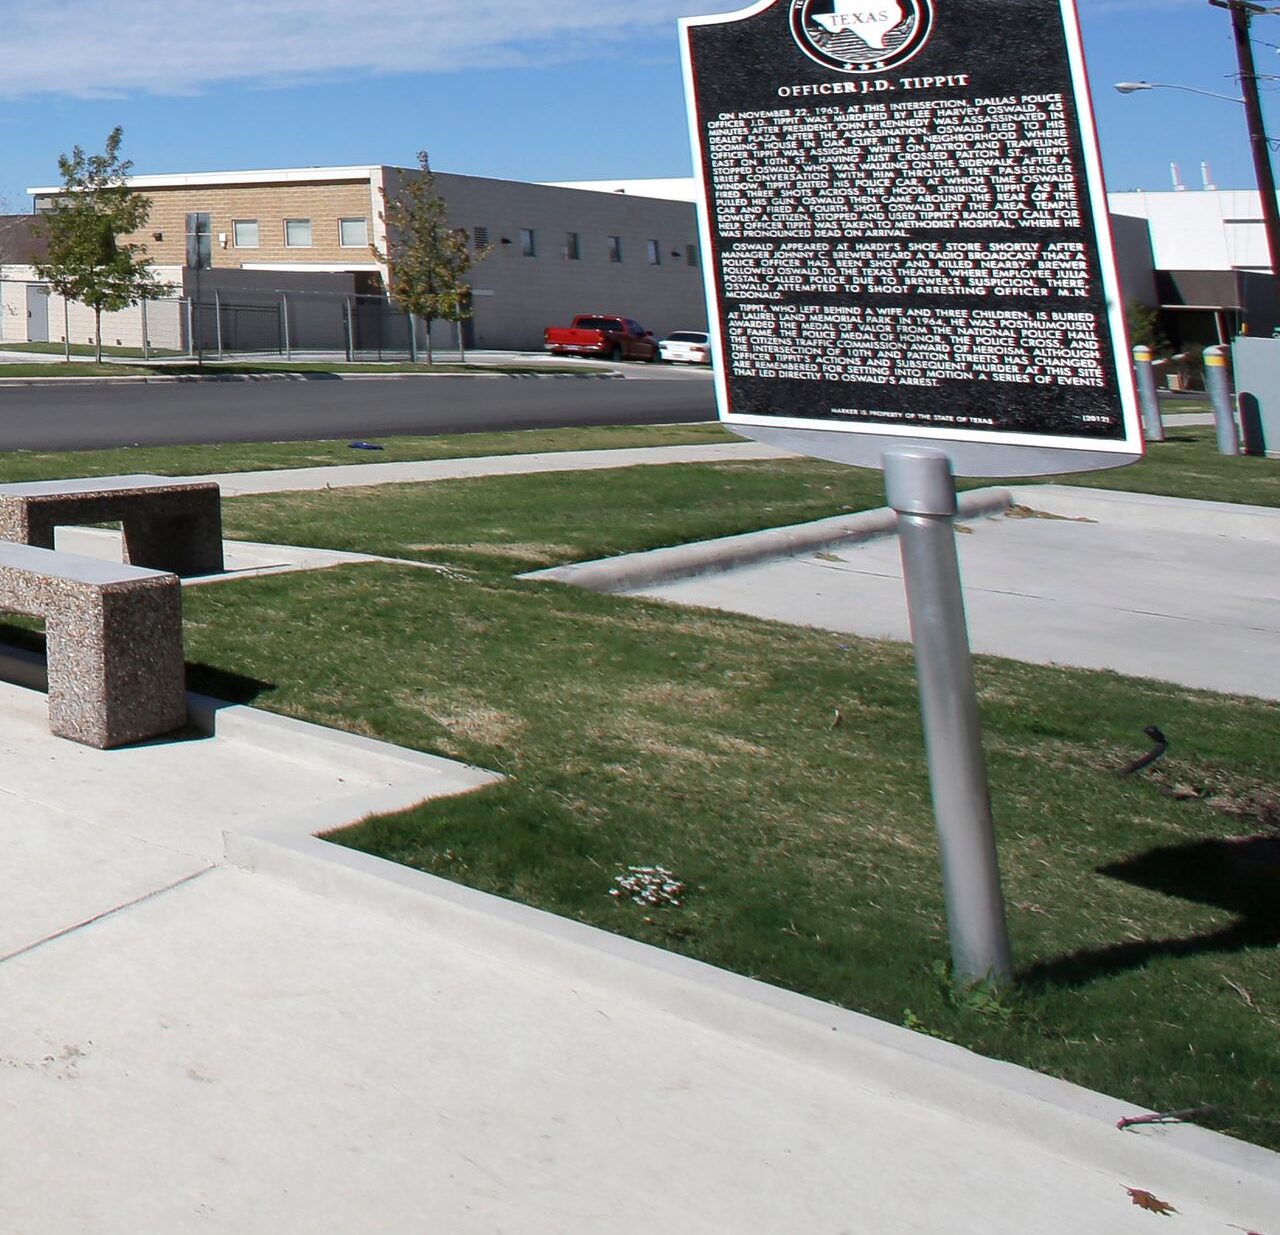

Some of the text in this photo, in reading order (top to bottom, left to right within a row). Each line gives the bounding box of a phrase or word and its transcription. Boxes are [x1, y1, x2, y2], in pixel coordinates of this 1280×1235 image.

[830, 10, 889, 27] TEXAS
[777, 74, 969, 97] OFFICER J.D. TIPPIT
[707, 120, 745, 129] OFFICER
[773, 117, 799, 126] TIPPIT
[804, 115, 828, 124] WAS
[833, 112, 888, 122] MURDERED
[893, 111, 907, 119] BY
[913, 110, 931, 118] LEE
[937, 107, 980, 117] HARVEY
[1048, 103, 1063, 111] 45
[718, 112, 735, 121] ON
[738, 109, 791, 120] NOVEMBER
[847, 105, 860, 114] AT
[864, 104, 886, 113] THIS
[975, 97, 1016, 107] DALLAS
[1021, 94, 1062, 104] POLICE
[709, 135, 743, 145] DEALEY
[785, 132, 814, 141] AFTER
[820, 131, 838, 140] THE
[936, 124, 984, 134] OSWALD
[990, 123, 1017, 132] FLED
[1023, 122, 1040, 130] TO
[1046, 120, 1066, 129] HIS
[710, 151, 748, 160] OFFICER
[753, 149, 779, 158] TIPPIT
[782, 148, 805, 157] WAS
[868, 145, 902, 154] WHILE
[906, 144, 925, 152] ON
[929, 142, 969, 151] PATROL
[974, 141, 1000, 149] AND
[1006, 138, 1068, 148] TRAVELING
[713, 165, 1072, 183] BRIEF CONVERSATION WITH HIM THROUGH THE PASSENGER
[766, 181, 791, 189] TIPPIT
[796, 180, 829, 189] EXITED
[833, 179, 850, 188] HIS
[854, 178, 891, 187] POLICE
[926, 177, 940, 185] AT
[945, 176, 985, 185] WHICH
[990, 175, 1016, 184] TIME
[1021, 174, 1074, 183] OSWALD
[716, 198, 748, 206] PULLED
[751, 198, 767, 206] HIS
[801, 196, 845, 205] OSWALD
[849, 196, 877, 204] THEN
[881, 195, 912, 203] CAME
[917, 194, 966, 203] AROUND
[971, 194, 992, 202] THE
[996, 193, 1026, 201] REAR
[1031, 192, 1049, 200] OF
[1054, 192, 1076, 200] THE
[744, 222, 783, 230] OFFICER
[786, 222, 811, 230] TIPPIT
[814, 221, 838, 229] WAS
[841, 221, 874, 229] TAKEN
[877, 221, 892, 229] TO
[894, 221, 955, 229] METHODIST
[1018, 220, 1061, 228] WHERE
[1064, 220, 1081, 228] HE
[732, 243, 1084, 251] OSWALD APPEARED AT HARDY'S SHOE STORE SHORTLY AFTER
[723, 275, 760, 283] POSTAL
[765, 276, 803, 284] CALLED
[809, 276, 846, 284] POLICE
[852, 277, 874, 285] DUE
[882, 277, 897, 285] TO
[904, 277, 961, 286] BREWER'S
[724, 283, 770, 291] OSWALD
[776, 284, 837, 292] ATTEMPTED
[845, 285, 860, 293] TO
[867, 285, 908, 294] SHOOT
[916, 286, 986, 295] ARRESTING
[994, 287, 1048, 296] OFFICER
[728, 320, 1098, 339] AWARDED THE MEDAL OF VALOR FROM THE NATIONAL POLICE HALL
[730, 335, 748, 344] THE
[749, 336, 792, 346] CITIZENS
[795, 338, 833, 347] TRAFFIC
[836, 340, 907, 350] COMMISSION
[910, 343, 950, 352] AWARD
[953, 345, 969, 353] OF
[1032, 348, 1100, 358] ALTHOUGH
[731, 352, 1103, 377] OFFICER TIPPIT'S ACTIONS AND SUBSEQUENT MURDER AT THIS SITE
[733, 368, 756, 377] THAT
[758, 369, 776, 378] LED
[778, 370, 821, 380] DIRECTLY
[825, 373, 839, 381] TO
[841, 374, 896, 385] OSWALD'S
